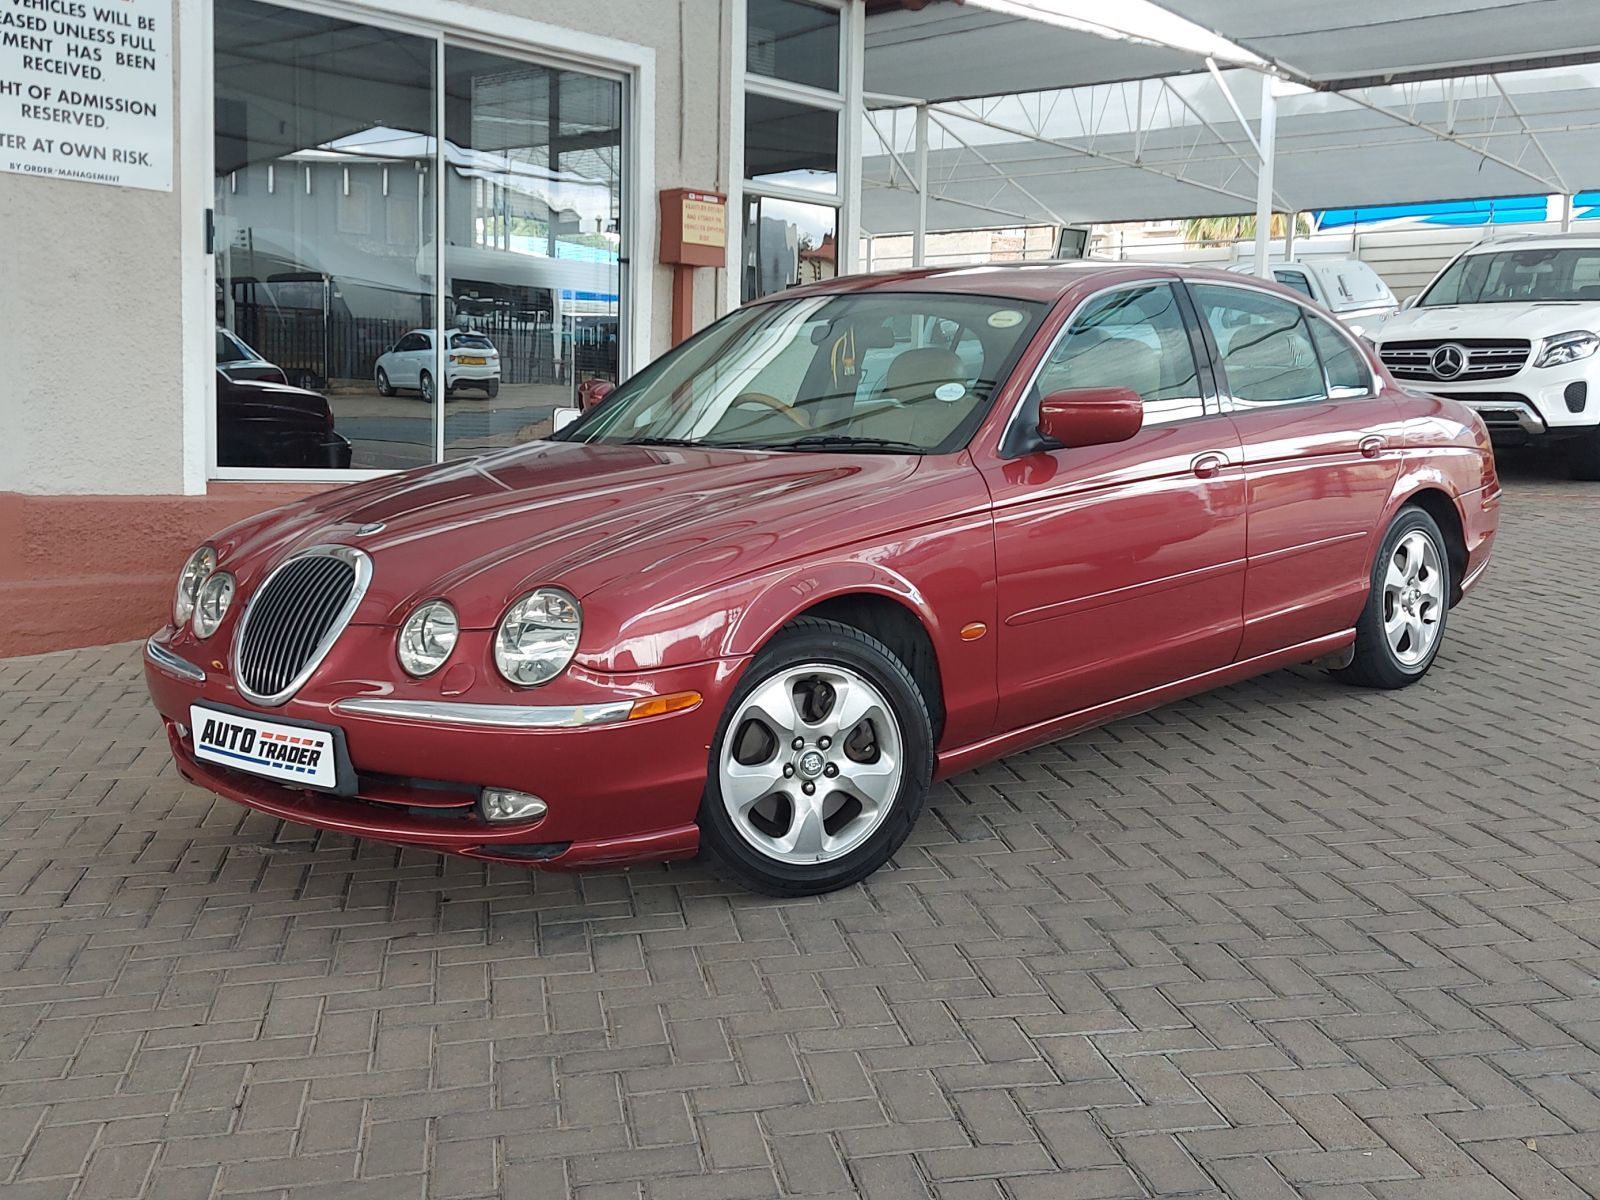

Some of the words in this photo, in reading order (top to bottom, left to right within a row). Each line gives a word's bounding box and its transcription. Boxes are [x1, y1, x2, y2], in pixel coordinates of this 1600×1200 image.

[0, 10, 47, 31] ASED
[54, 20, 115, 45] UNLESS
[121, 33, 156, 52] FULL
[93, 7, 131, 27] WILL
[138, 16, 155, 32] BE
[0, 31, 53, 53] MENT
[67, 43, 102, 62] HAS
[116, 52, 156, 71] BEEN
[23, 55, 106, 82] RECEIVED.
[28, 85, 52, 101] OF
[57, 89, 157, 117] ADMISSION
[21, 103, 109, 130] RESERVED.
[9, 162, 21, 171] BY
[32, 138, 54, 153] AT
[60, 141, 106, 161] OWN
[112, 148, 153, 168] RISK.
[201, 719, 257, 753] AUTO
[258, 741, 322, 767] TRADER
